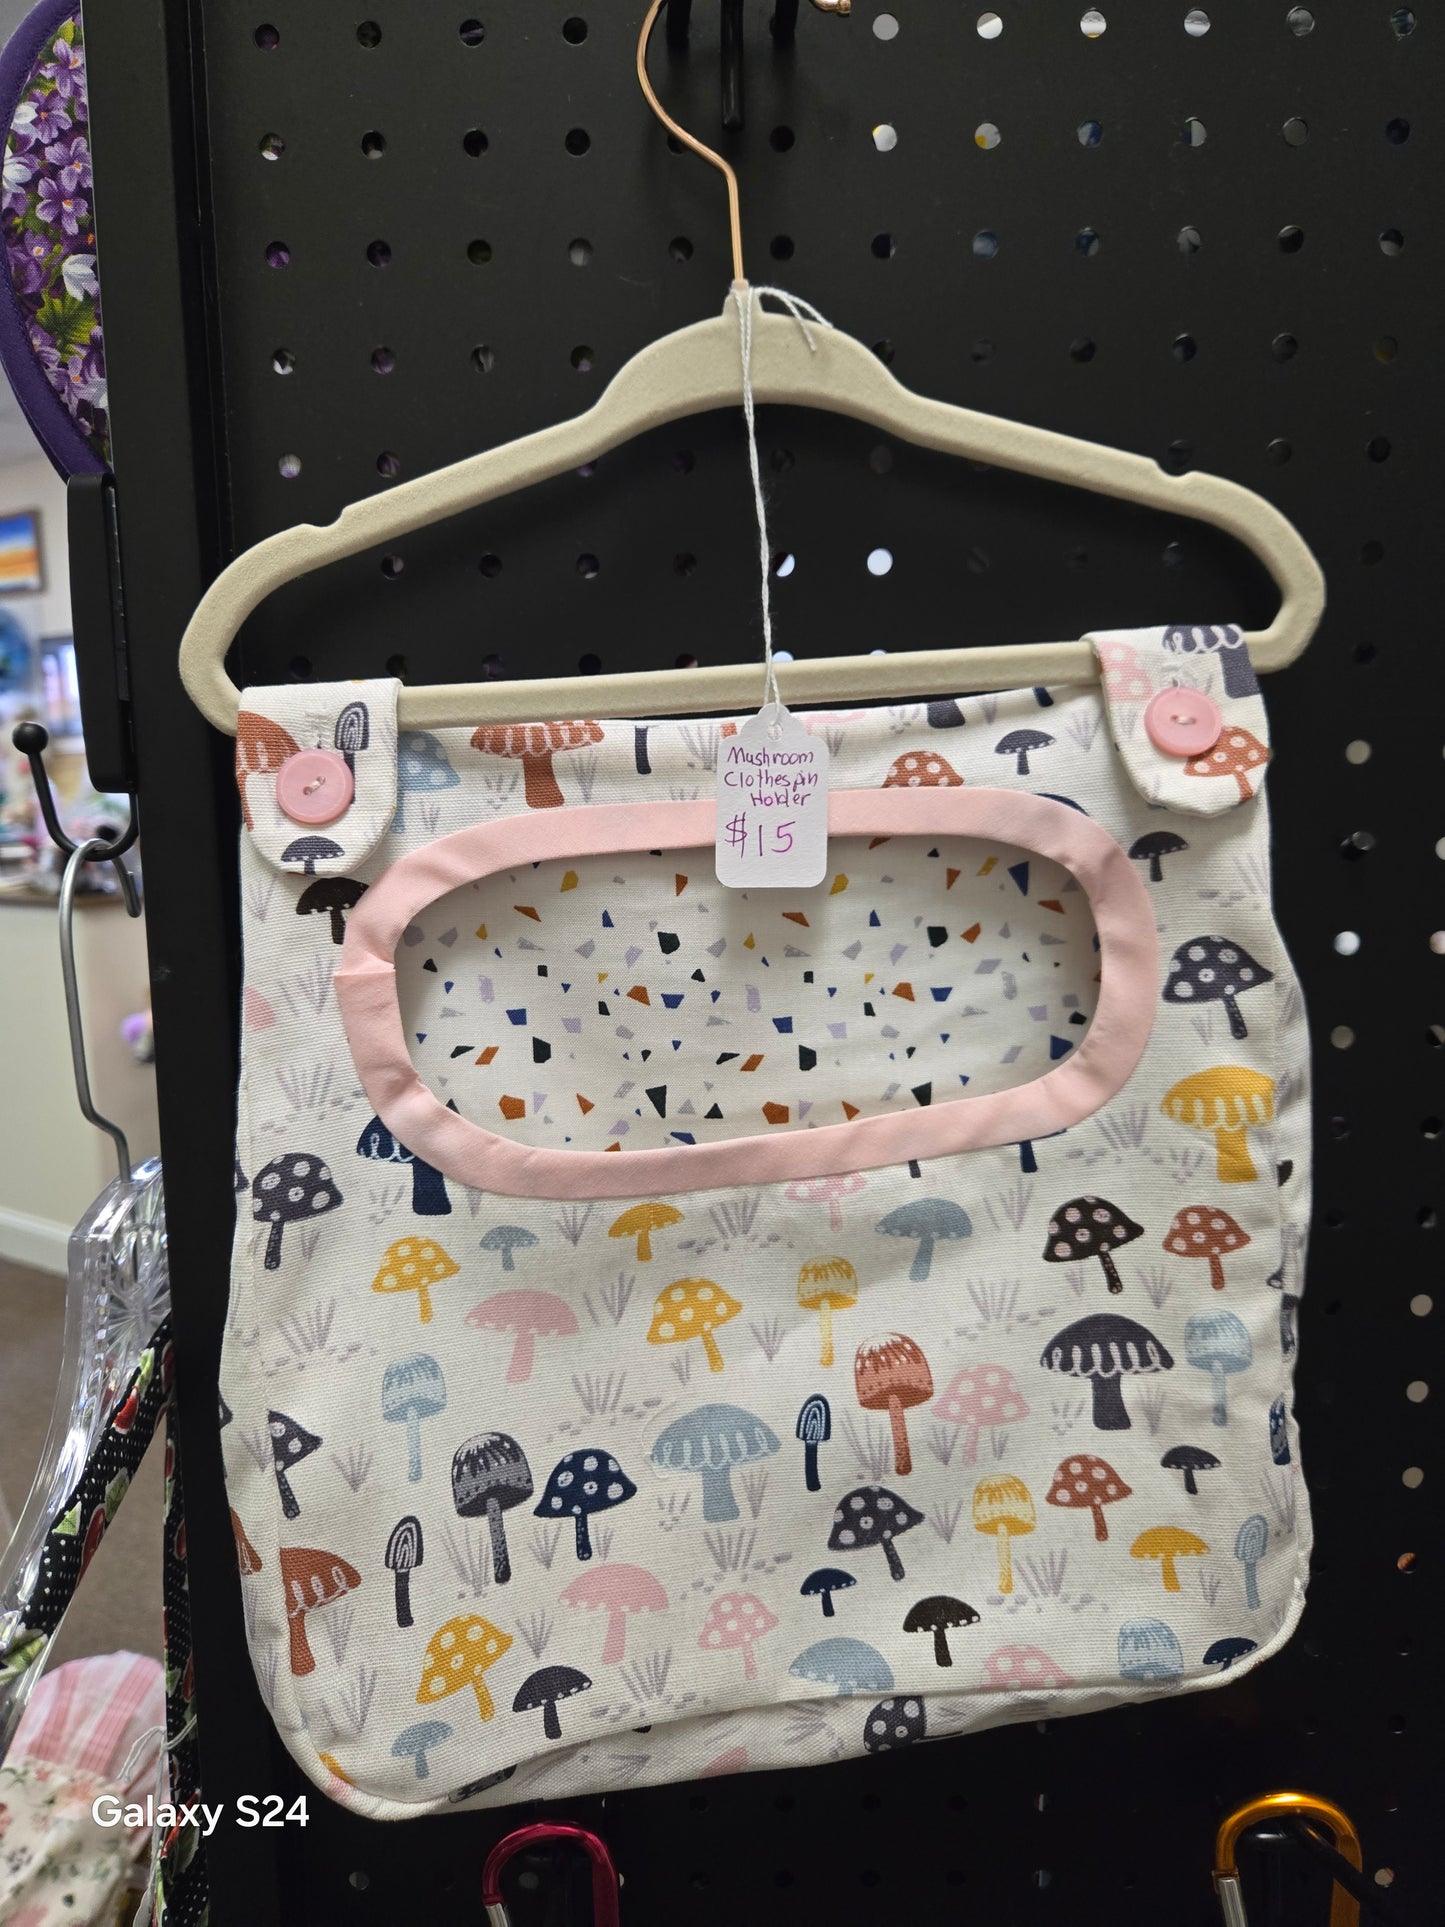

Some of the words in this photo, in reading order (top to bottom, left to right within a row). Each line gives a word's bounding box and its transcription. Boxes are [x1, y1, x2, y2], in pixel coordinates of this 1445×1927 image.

[727, 746, 814, 767] Mushroom
[750, 788, 812, 807] Holder
[724, 811, 796, 859] $15
